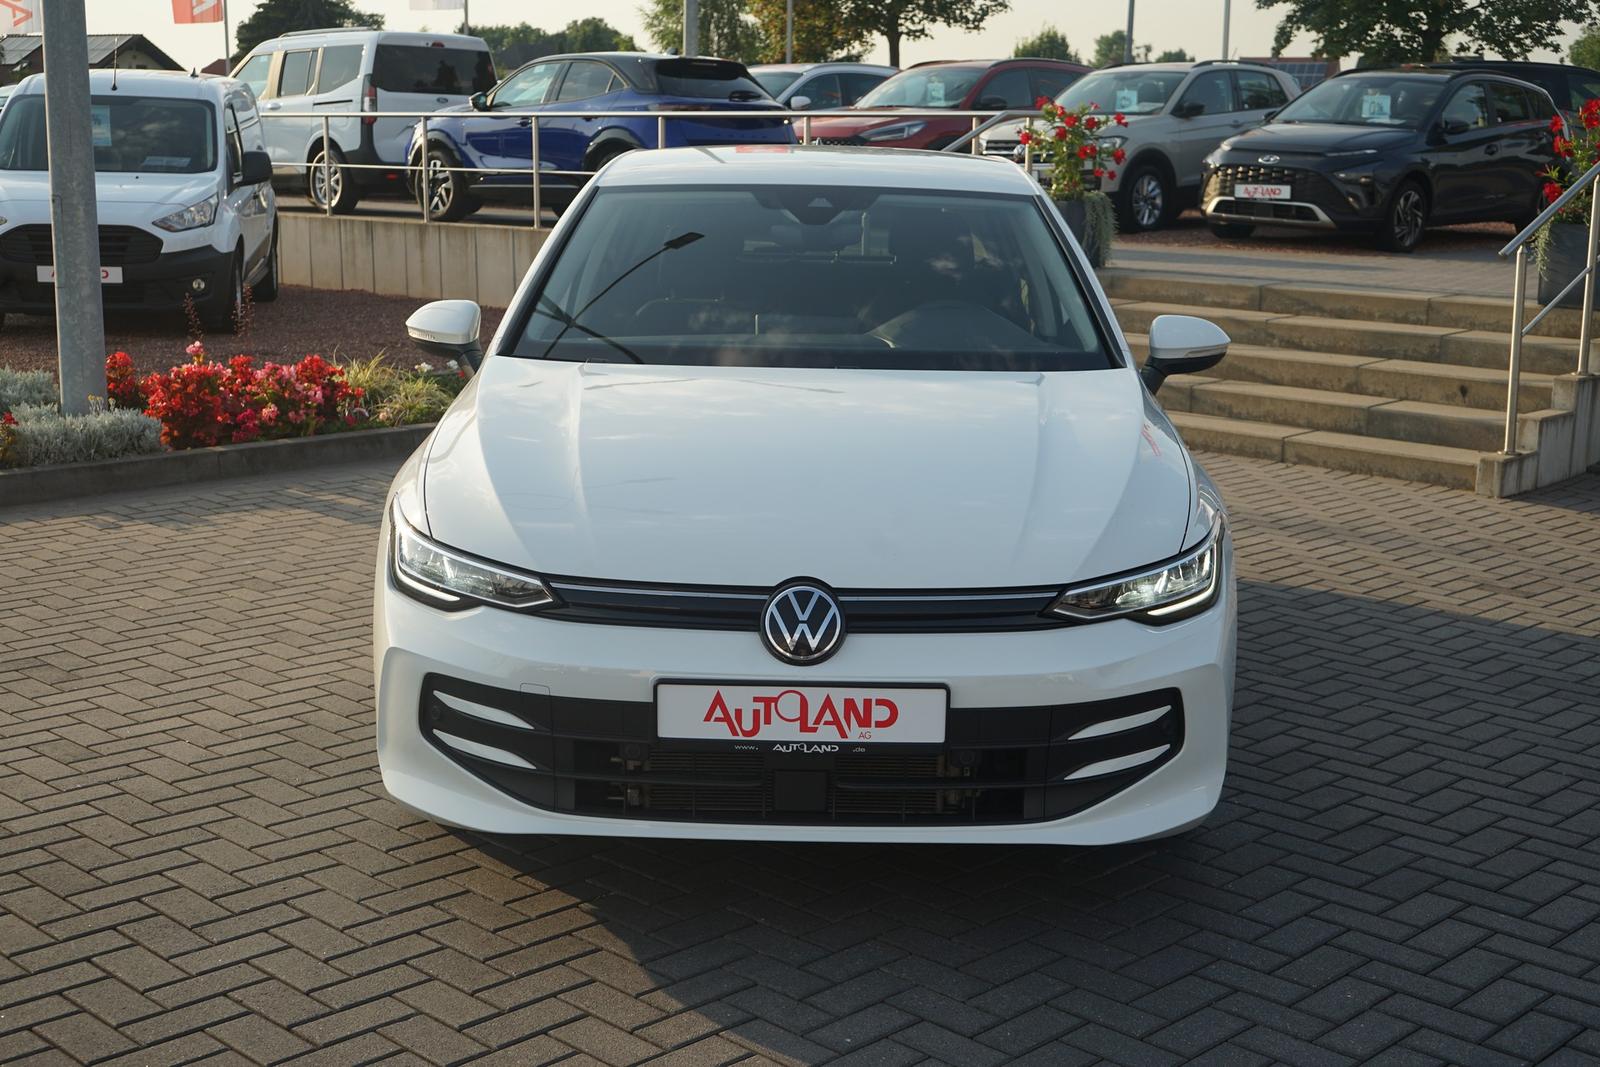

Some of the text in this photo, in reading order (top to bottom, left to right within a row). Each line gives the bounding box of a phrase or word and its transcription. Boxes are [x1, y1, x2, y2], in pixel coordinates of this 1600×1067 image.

[766, 587, 839, 656] VW
[703, 689, 899, 739] AUTOLAND
[773, 742, 839, 753] AUTOLAND
[858, 731, 872, 740] AG
